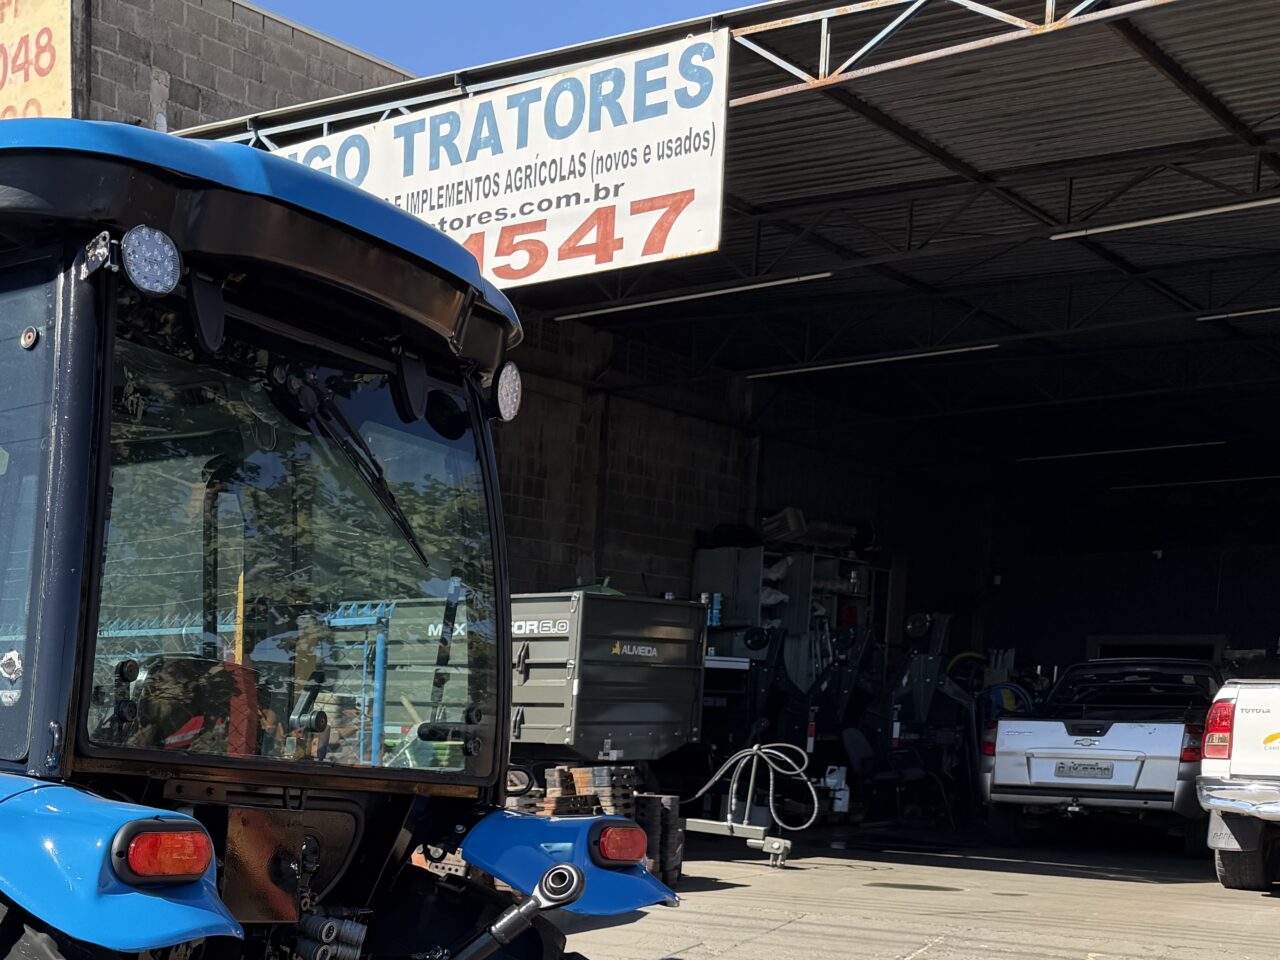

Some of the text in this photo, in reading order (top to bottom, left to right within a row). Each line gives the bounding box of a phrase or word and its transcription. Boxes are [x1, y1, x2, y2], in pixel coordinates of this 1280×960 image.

[393, 42, 715, 177] TRATORES
[405, 172, 500, 214] IMPLEMENTOS
[504, 152, 587, 195] AGRÍCOLAS
[590, 147, 638, 183] (novos
[643, 149, 651, 164] e
[656, 121, 716, 161] usados)
[427, 623, 466, 637] MX
